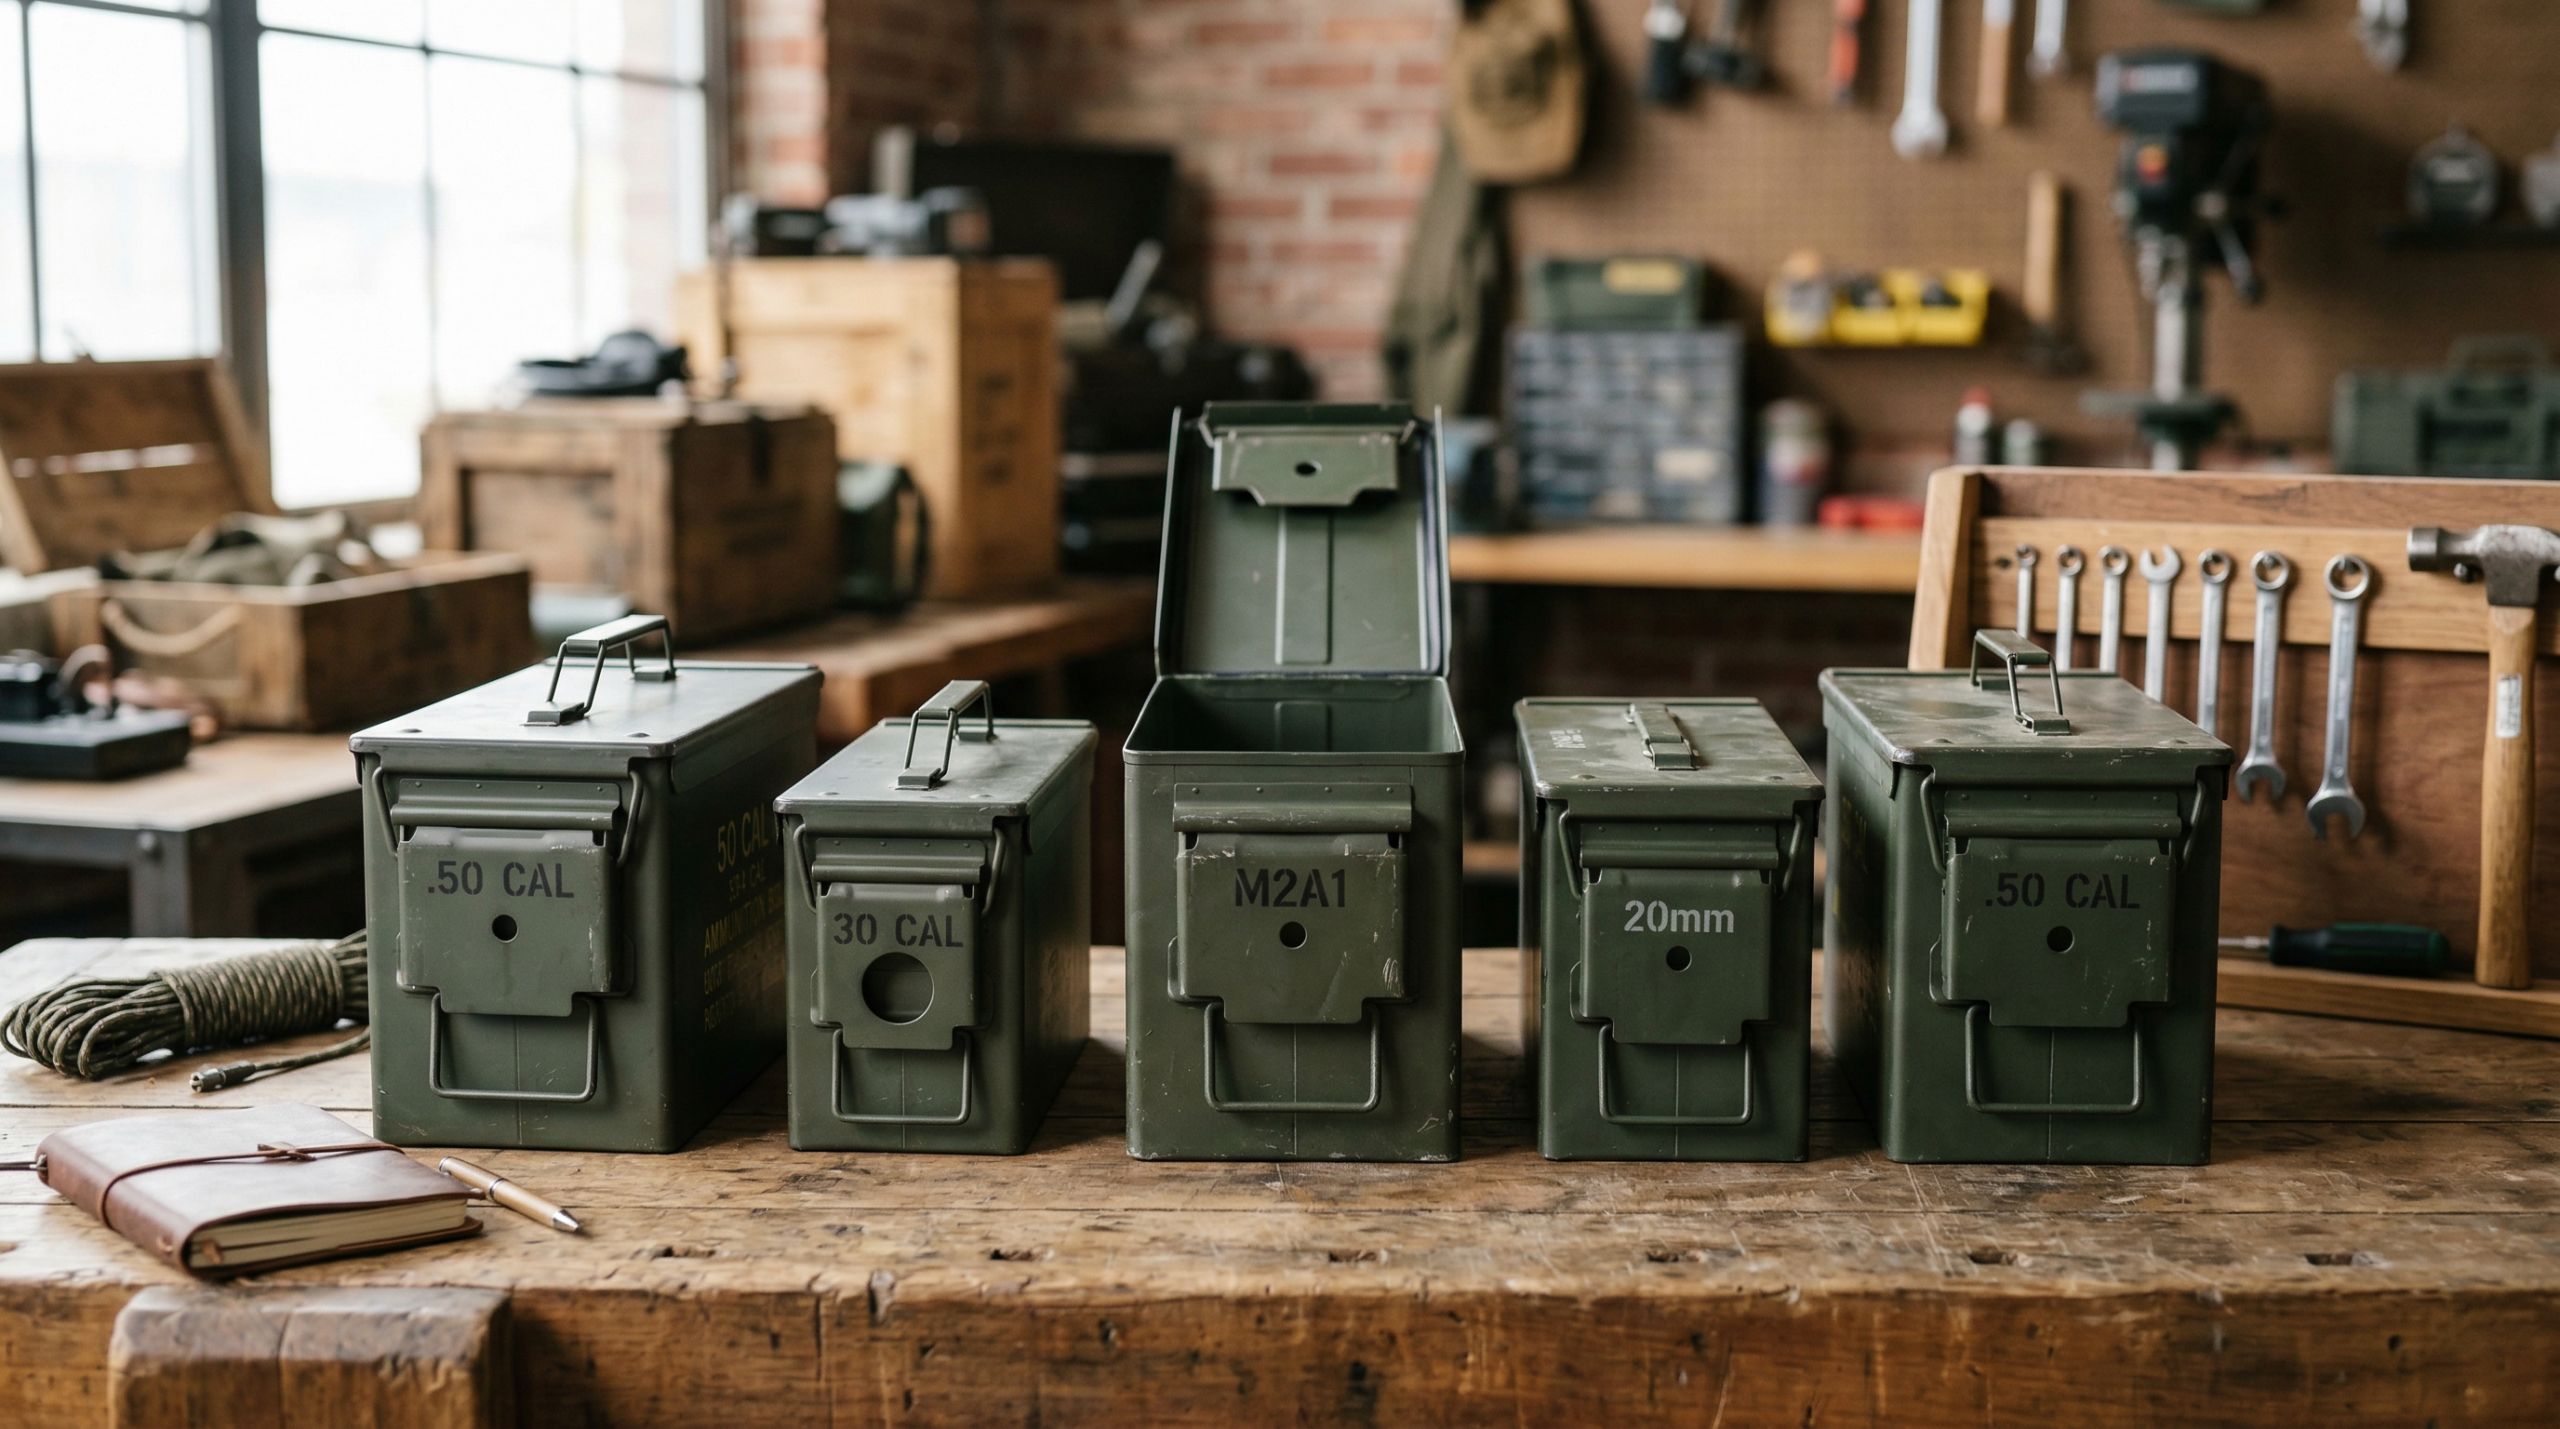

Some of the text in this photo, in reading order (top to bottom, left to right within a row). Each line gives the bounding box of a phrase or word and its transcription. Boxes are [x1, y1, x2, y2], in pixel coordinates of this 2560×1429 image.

[717, 802, 770, 874] 50 CAL
[427, 860, 575, 899] .50 CAL
[1235, 868, 1346, 908] M2A1
[1985, 872, 2141, 909] .50 CAL
[833, 912, 964, 948] 30 CAL
[1623, 900, 1735, 933] 20mm
